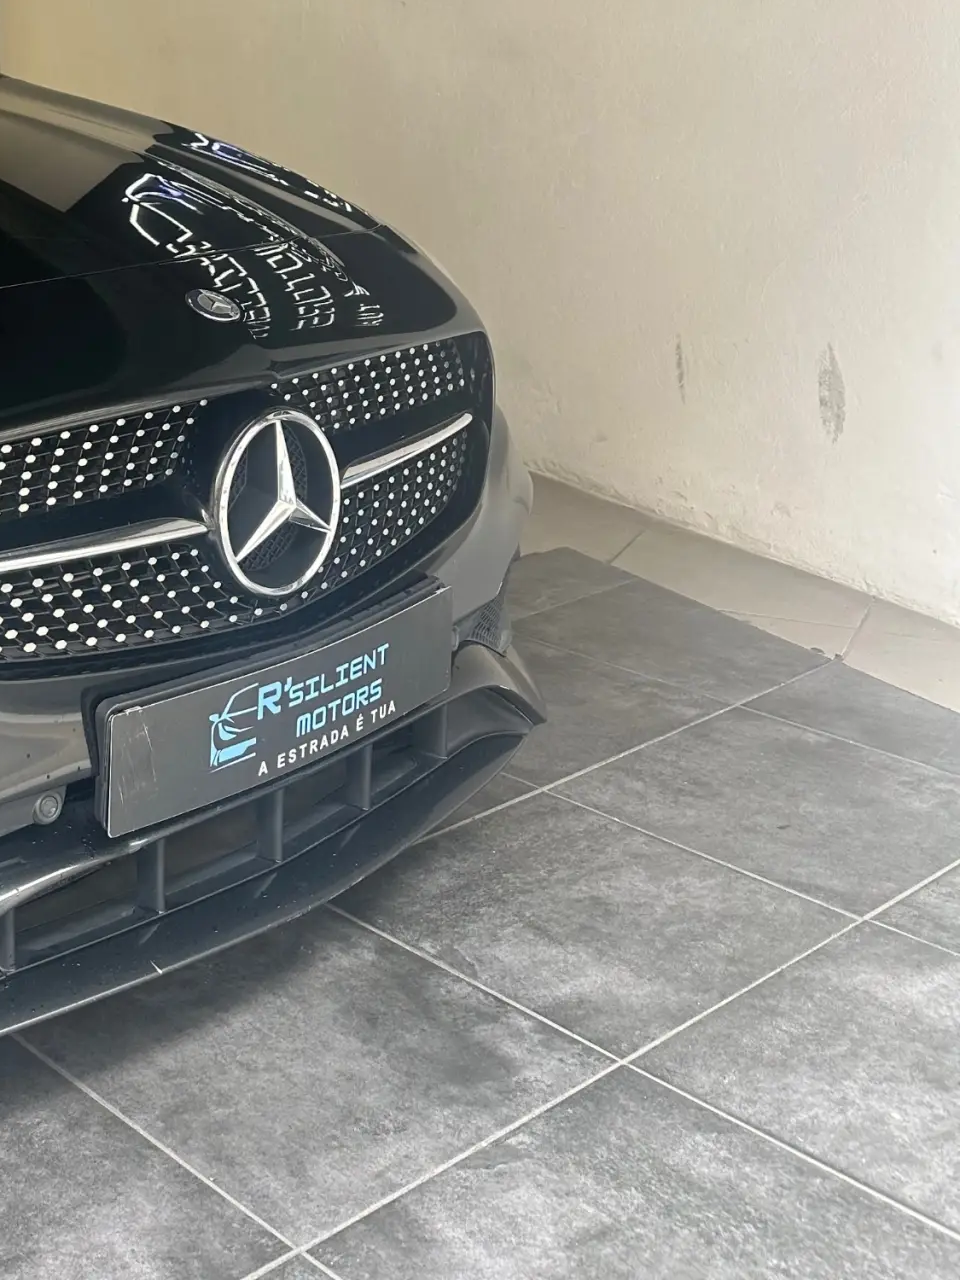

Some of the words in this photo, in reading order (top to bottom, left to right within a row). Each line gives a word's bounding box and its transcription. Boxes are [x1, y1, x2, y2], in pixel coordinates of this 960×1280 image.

[257, 643, 390, 719] R'SILIENT
[296, 678, 383, 737] MOTORS
[258, 761, 269, 776] A
[277, 724, 349, 768] ESTRADA
[356, 714, 365, 731] É
[371, 700, 396, 723] TUA
